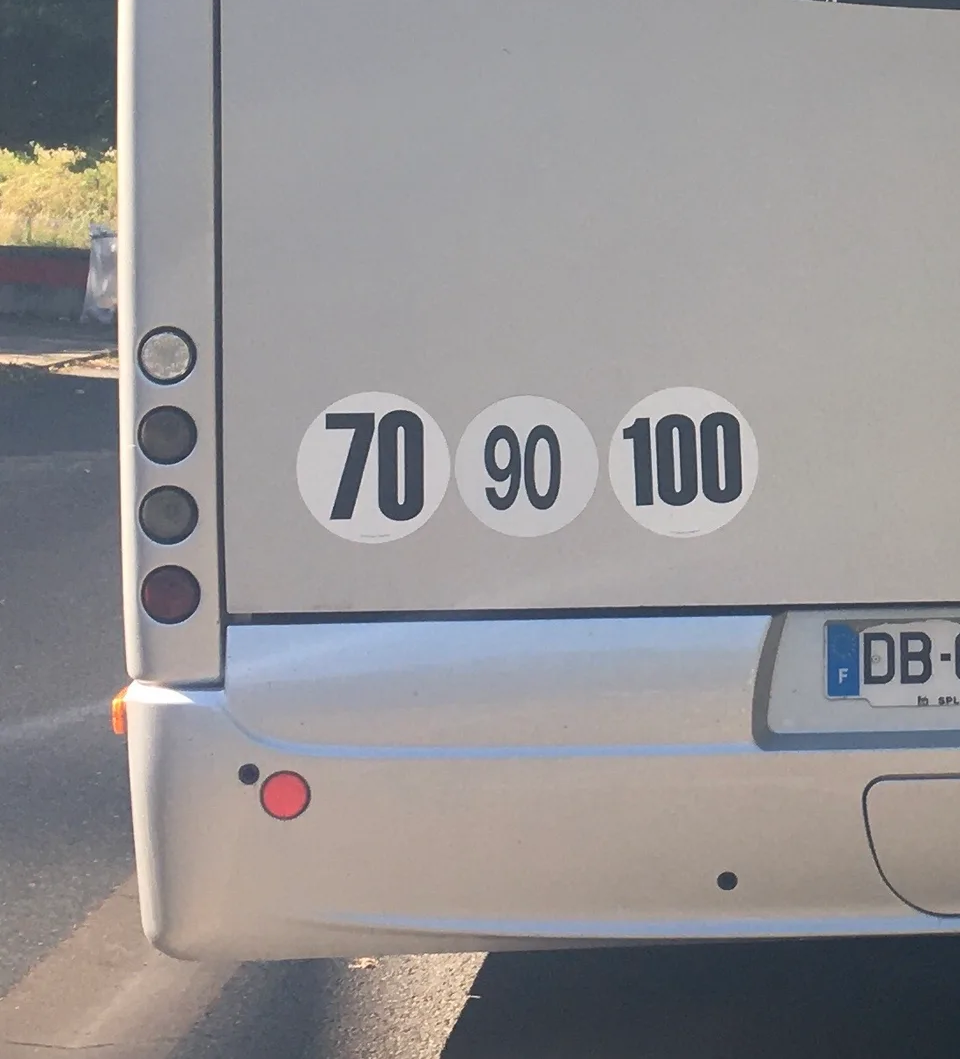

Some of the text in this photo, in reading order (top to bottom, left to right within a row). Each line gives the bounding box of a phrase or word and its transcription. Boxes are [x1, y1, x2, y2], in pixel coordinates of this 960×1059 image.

[325, 409, 425, 522] 70
[484, 424, 562, 511] 90
[622, 411, 744, 507] 100
[838, 668, 849, 684] F
[938, 696, 960, 705] SPL
